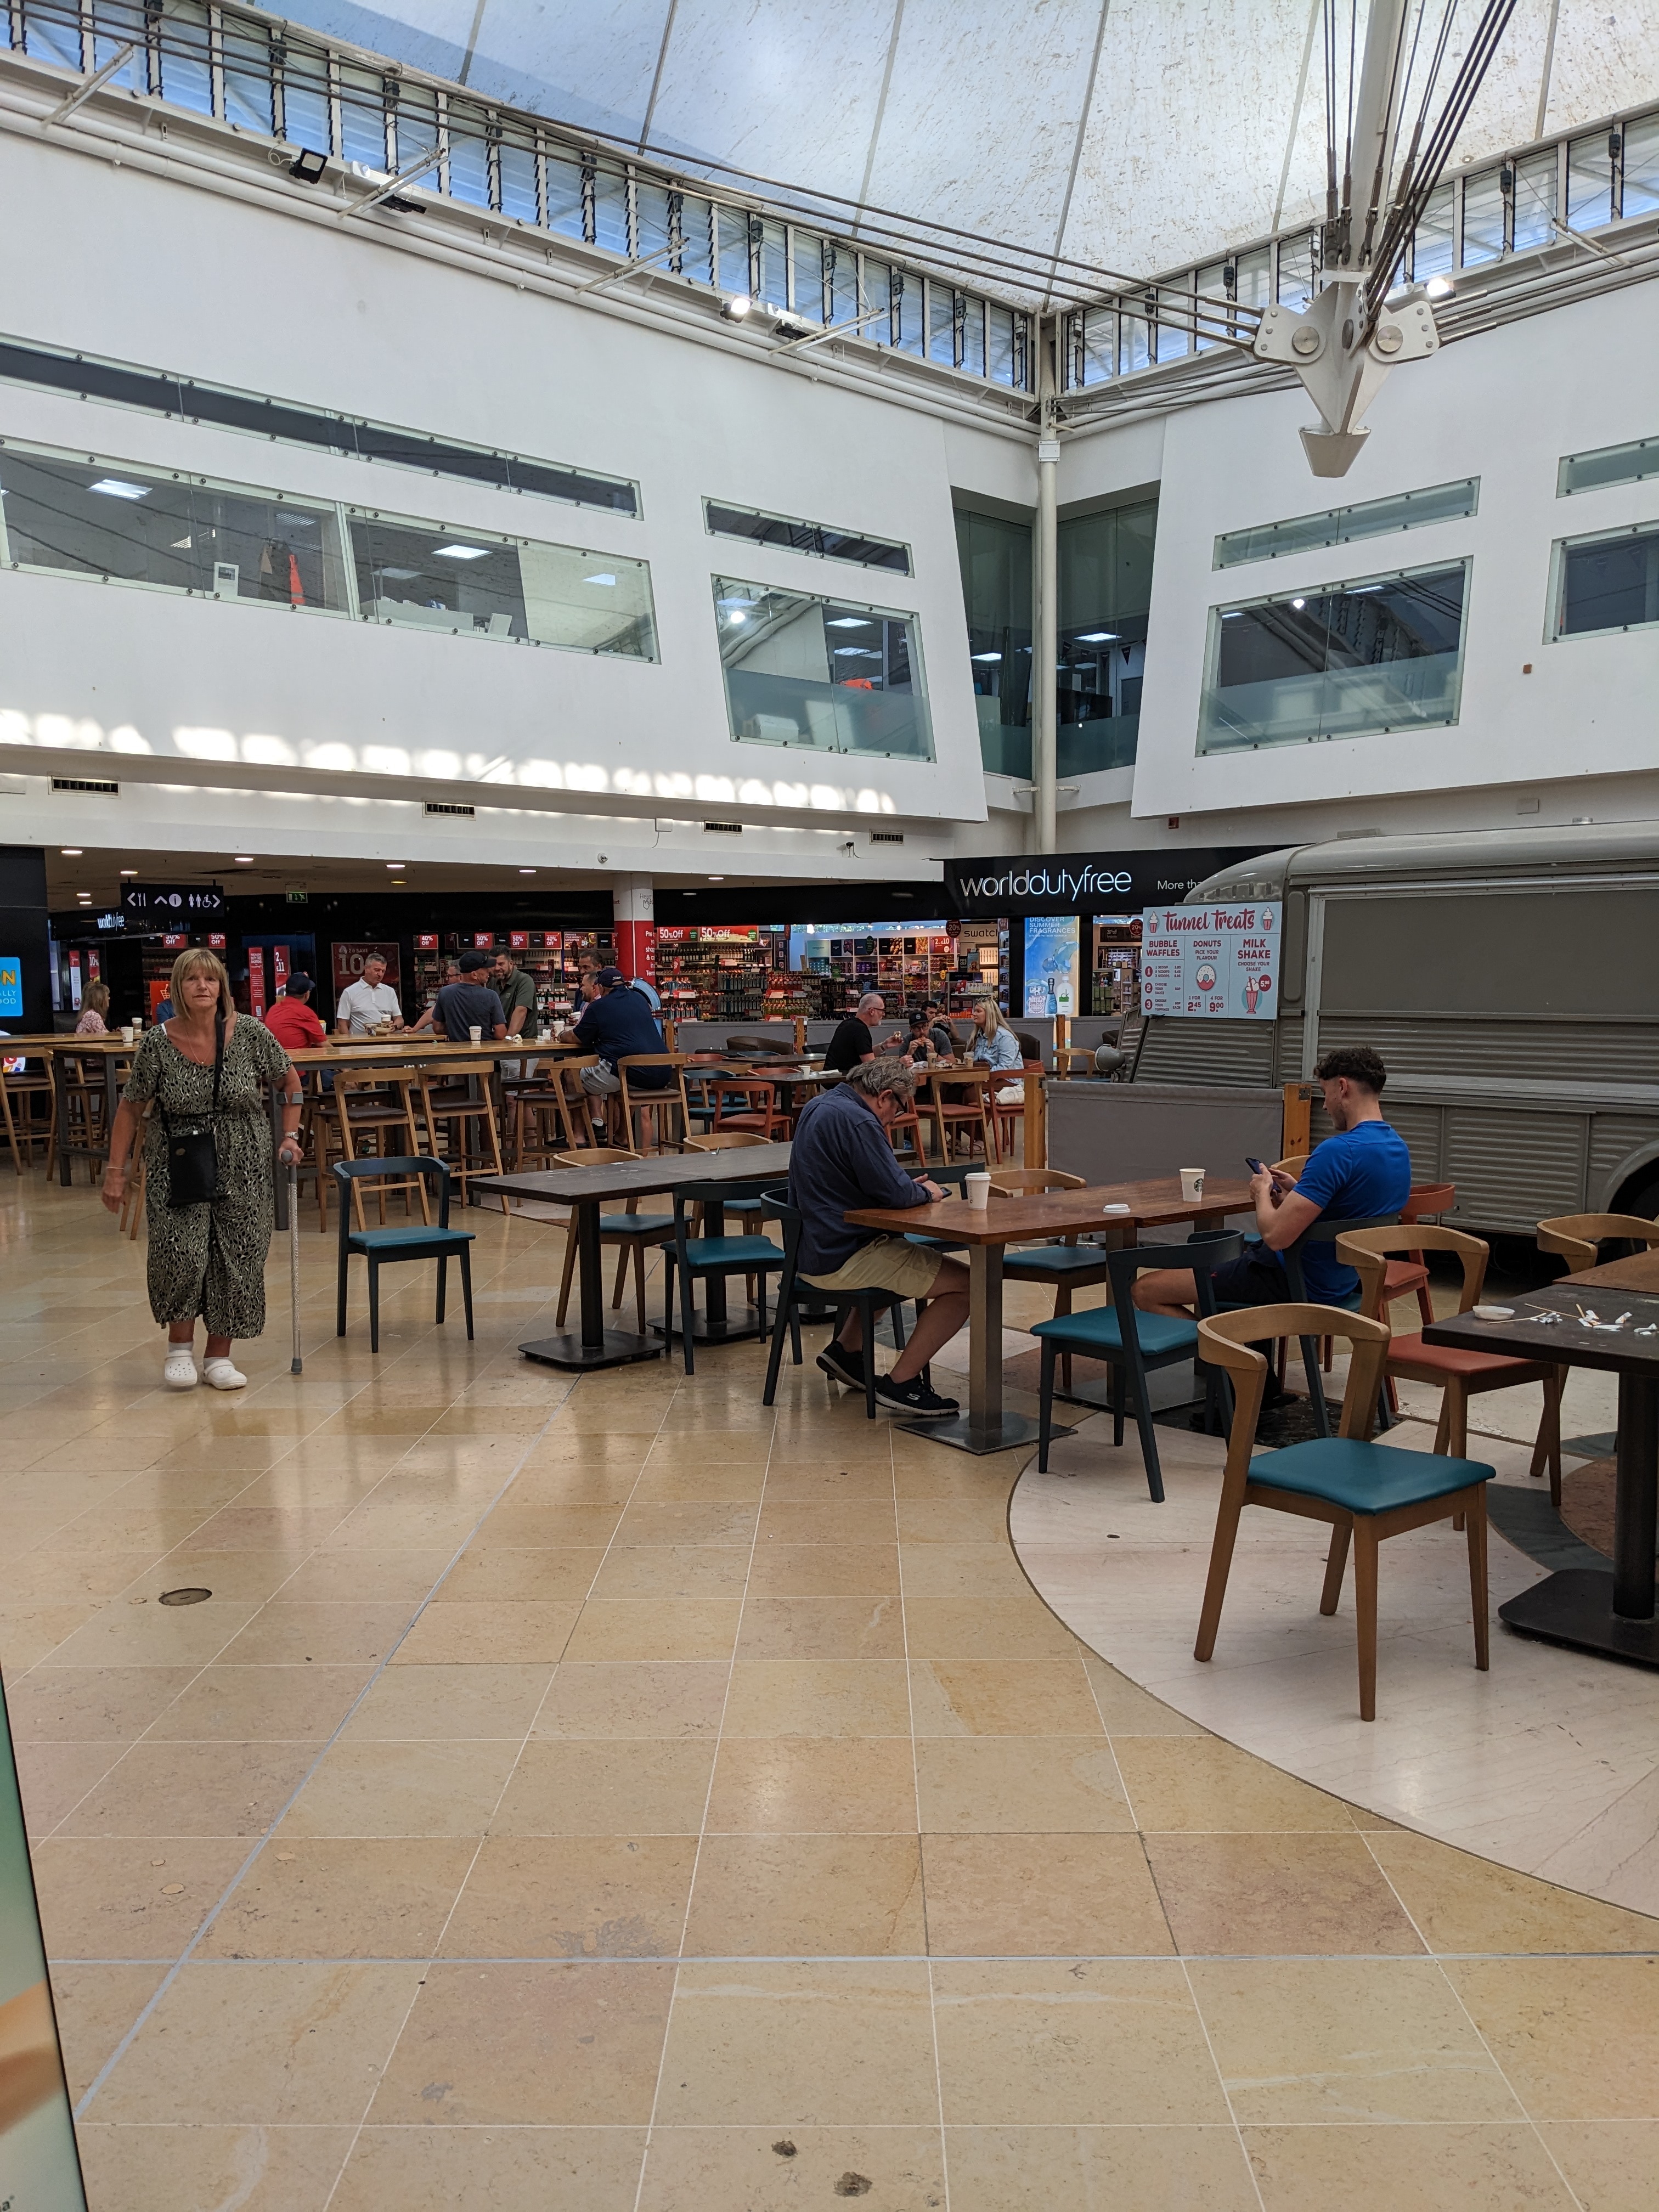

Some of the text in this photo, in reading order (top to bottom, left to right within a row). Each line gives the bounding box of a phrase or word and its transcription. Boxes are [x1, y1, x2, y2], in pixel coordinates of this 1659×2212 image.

[960, 865, 1132, 901] worlddutyfree
[1158, 879, 1201, 890] More th
[1243, 939, 1266, 948] MILK
[276, 952, 279, 962] 2
[1238, 950, 1271, 959] SHAKE
[89, 956, 99, 966] 10%
[276, 962, 285, 972] £11
[1060, 989, 1069, 1000] ck
[1188, 1002, 1201, 1012] 2.45
[1209, 1002, 1224, 1012] 9.00
